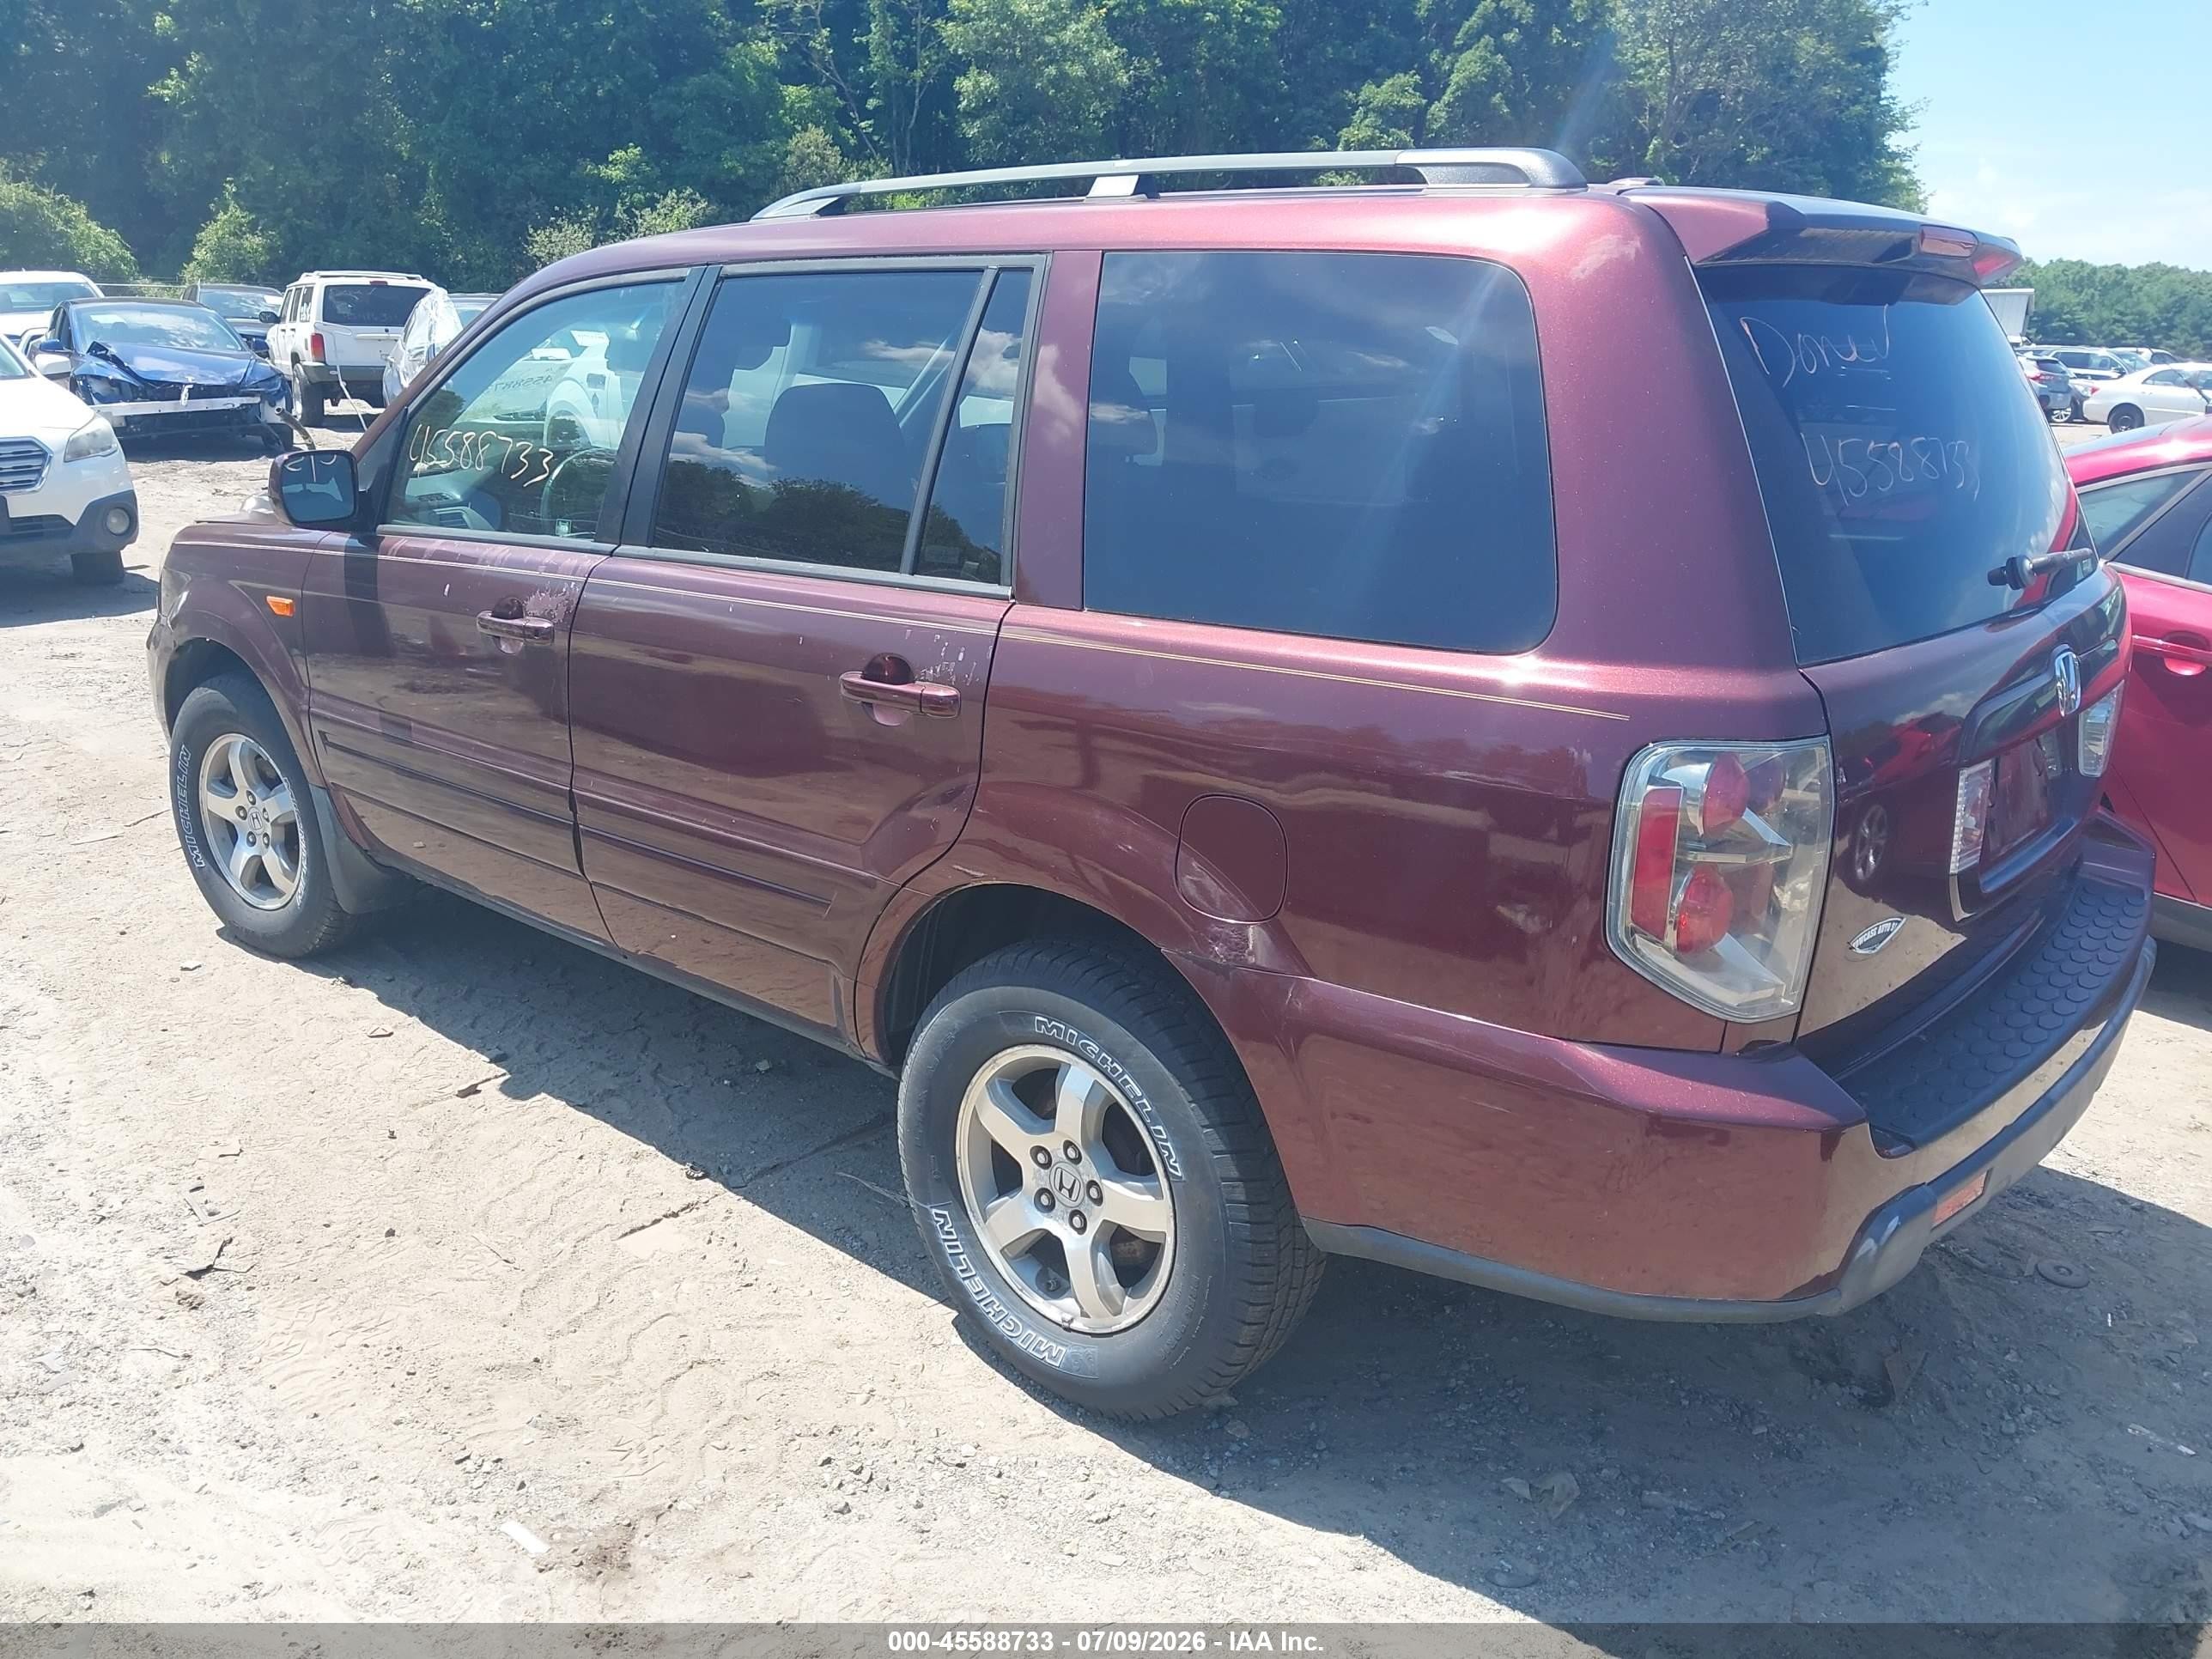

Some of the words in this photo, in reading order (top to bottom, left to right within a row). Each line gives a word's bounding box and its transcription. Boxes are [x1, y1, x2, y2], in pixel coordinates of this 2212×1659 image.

[409, 424, 554, 487] 45588733
[174, 743, 205, 868] MICHELIN
[1035, 1017, 1184, 1178] MICHELIN
[931, 1206, 1066, 1369] MICHELIN
